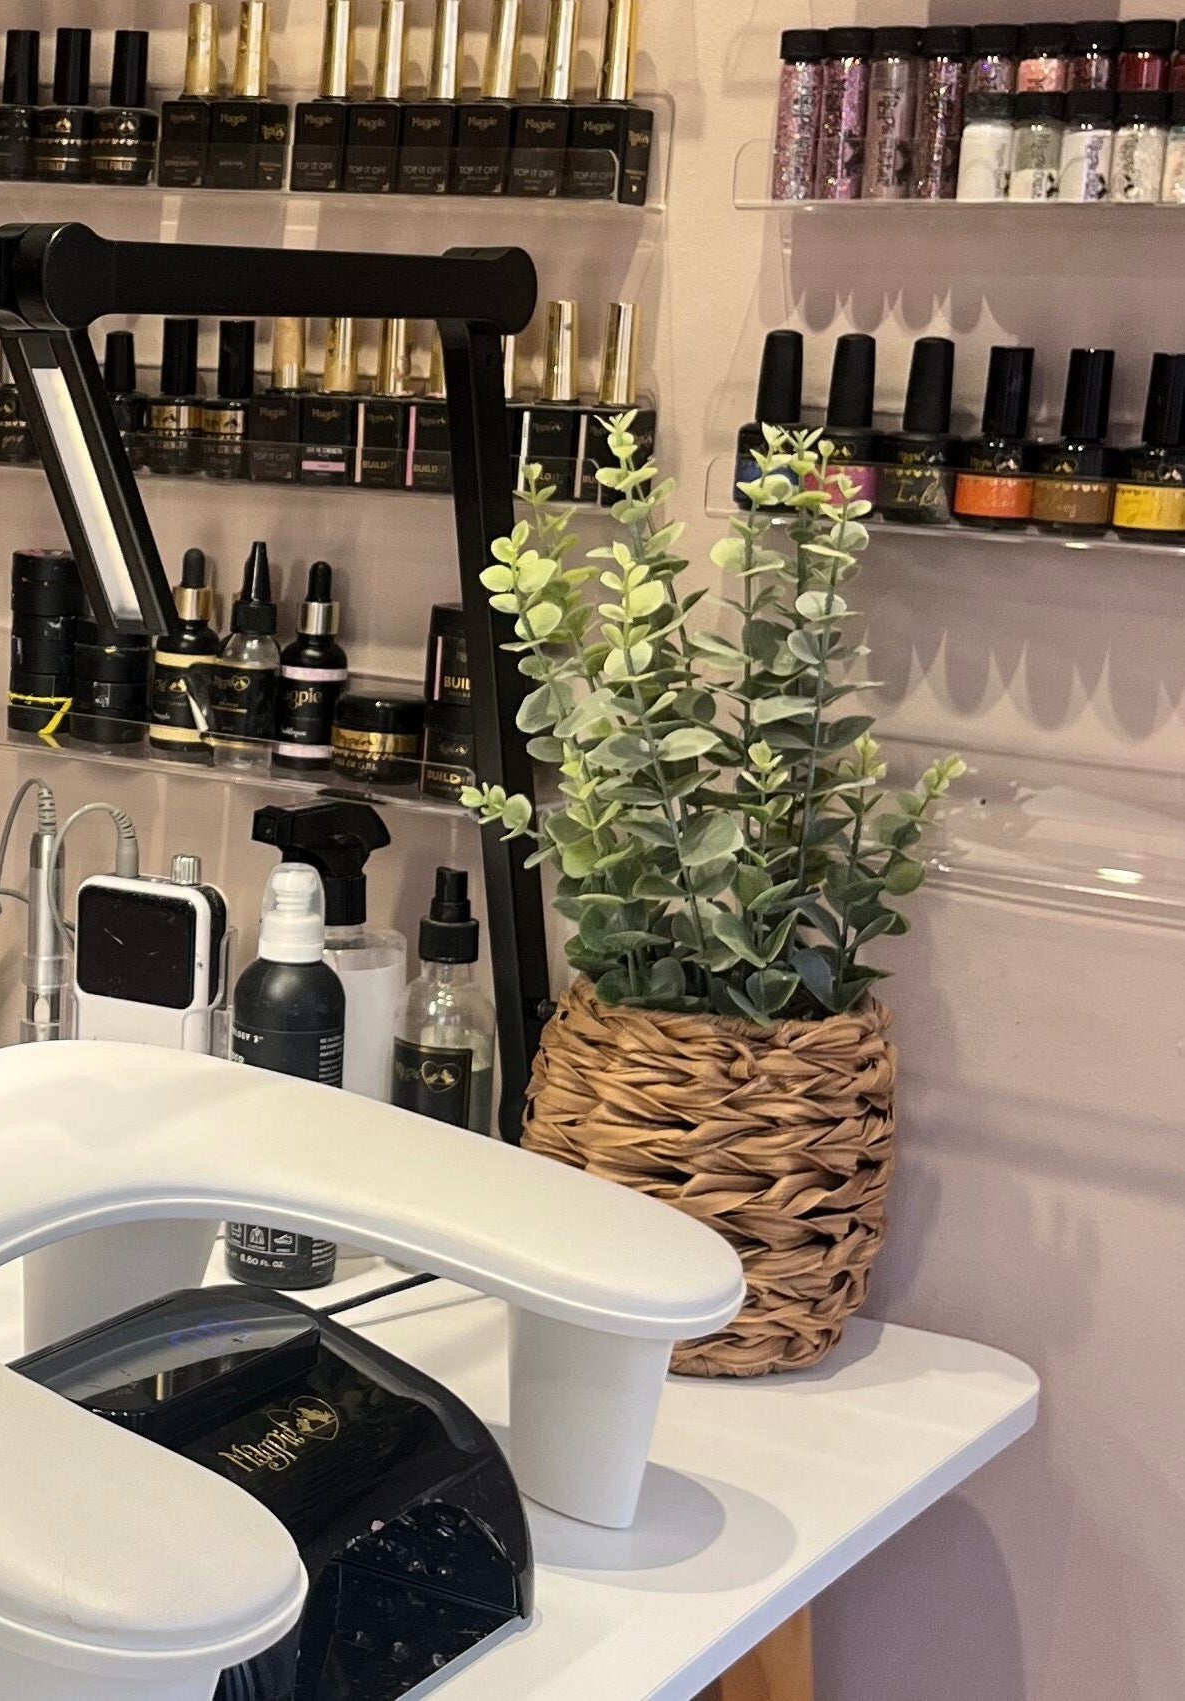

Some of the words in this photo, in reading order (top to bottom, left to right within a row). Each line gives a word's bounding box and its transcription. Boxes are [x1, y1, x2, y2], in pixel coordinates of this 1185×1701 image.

[444, 676, 471, 690] BUIL
[283, 687, 323, 710] gpie
[217, 1421, 305, 1472] Magpie
